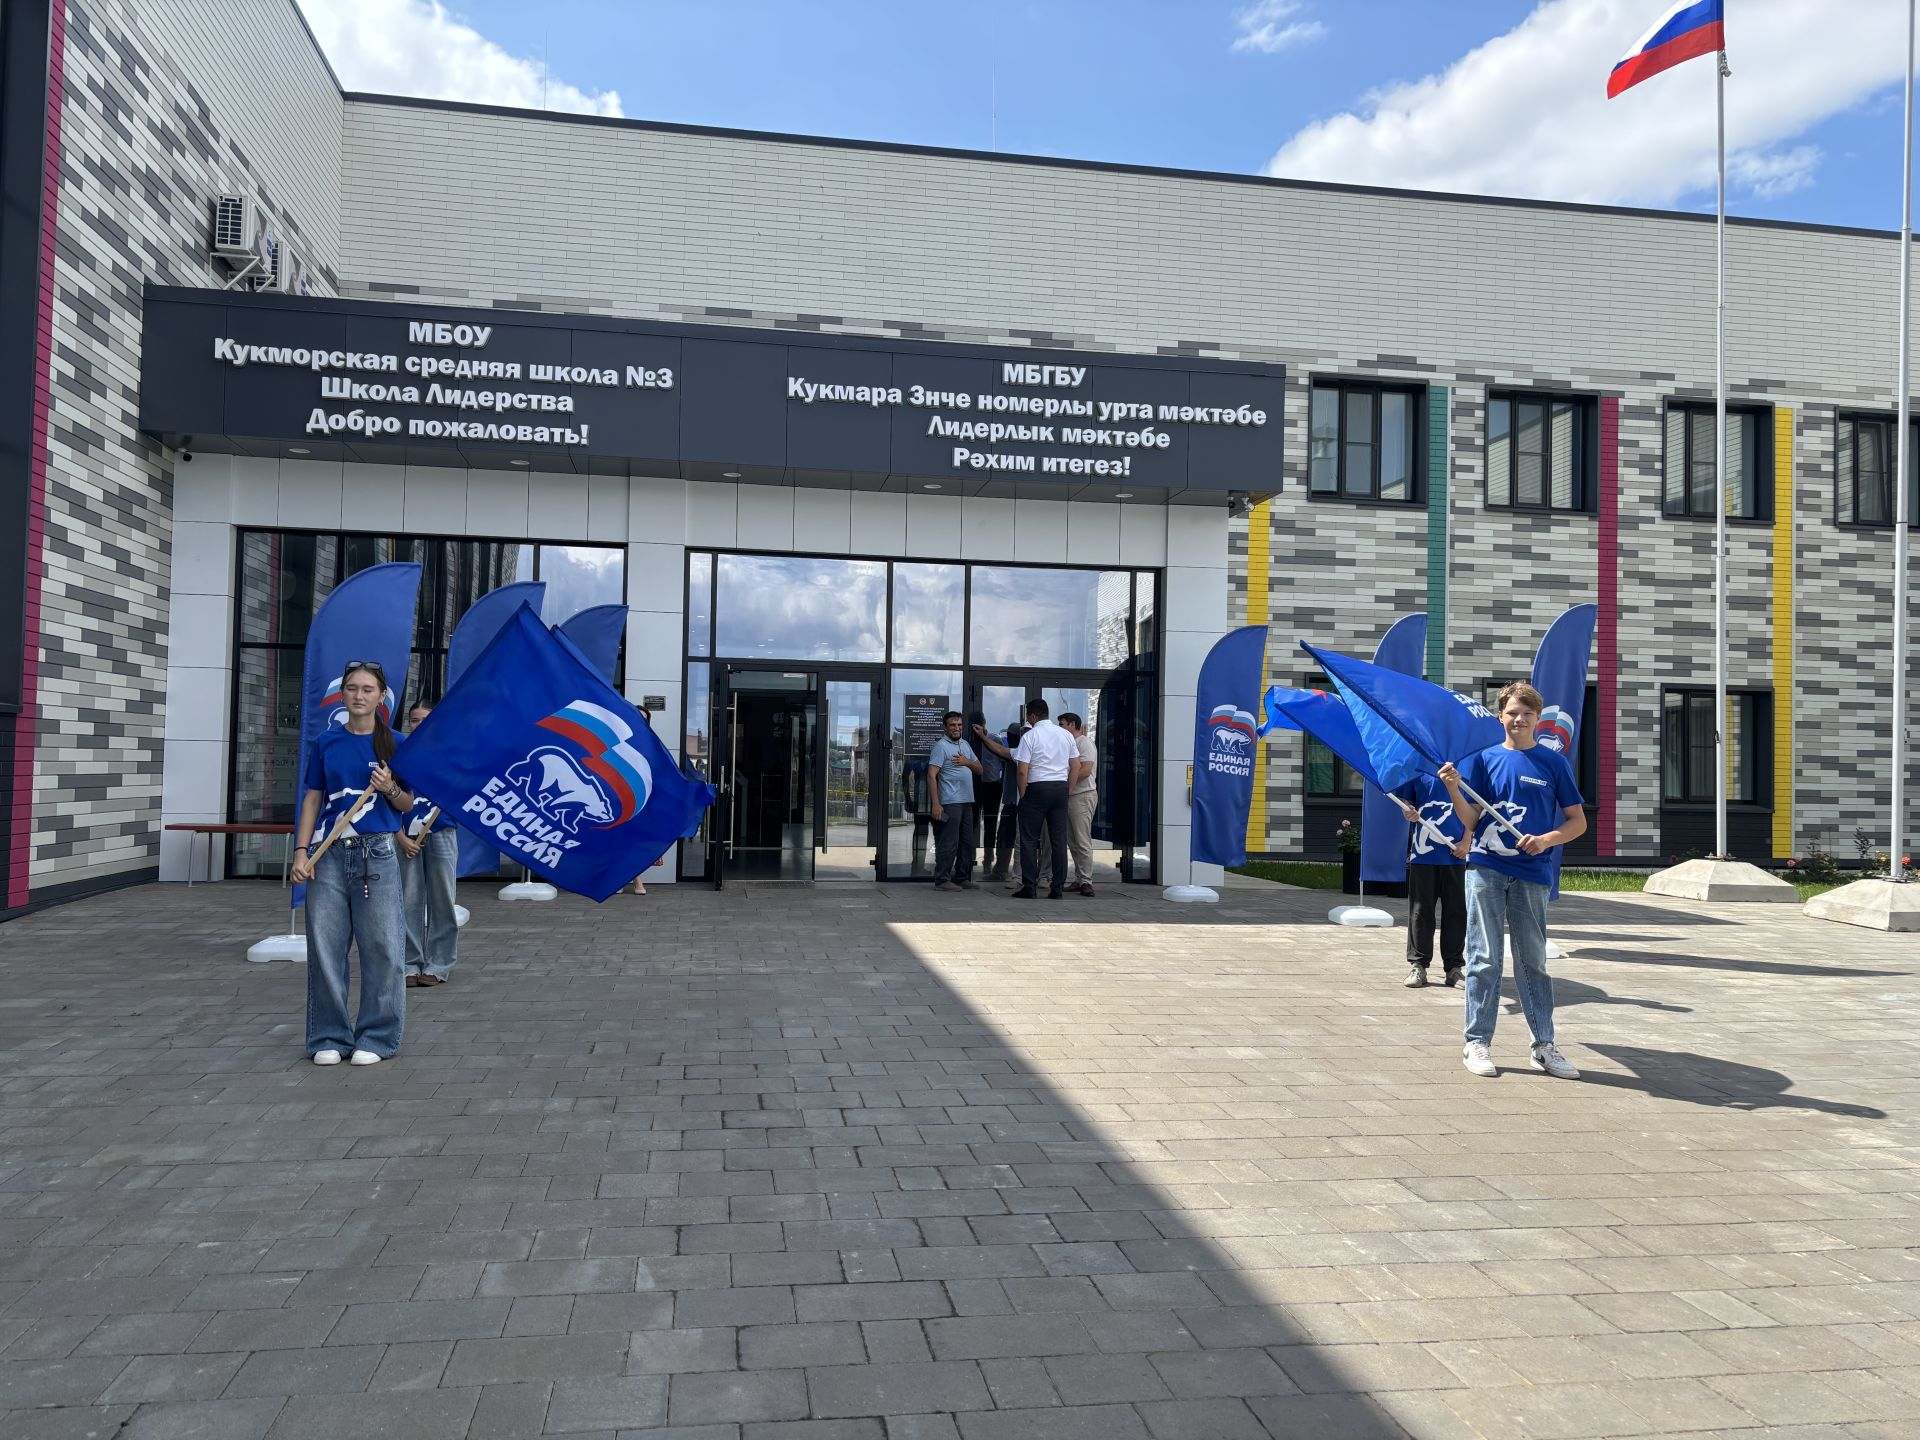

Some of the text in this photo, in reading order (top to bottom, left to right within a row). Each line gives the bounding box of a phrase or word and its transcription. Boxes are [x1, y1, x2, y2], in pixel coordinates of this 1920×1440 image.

[409, 321, 492, 347] МБОУ
[214, 337, 673, 388] Кукморская средняя школа №3
[1003, 362, 1087, 387] МБГБУ
[321, 376, 574, 413] Школа Лидерства
[788, 376, 902, 407] Кукмара
[977, 394, 1093, 419] номерлы
[1098, 401, 1154, 422] урта
[1158, 404, 1267, 426] мәктәбе
[305, 408, 590, 446] Добро пожаловать!
[926, 415, 1171, 449] Лидерлык мәктәбе
[952, 447, 1131, 477] Рәхим итегез!
[1208, 752, 1251, 767] ЕДИНАЯ
[1208, 762, 1250, 777] РОССИЯ
[481, 776, 582, 850] ЕДИНАЯ
[461, 794, 564, 869] РОССИЯ
